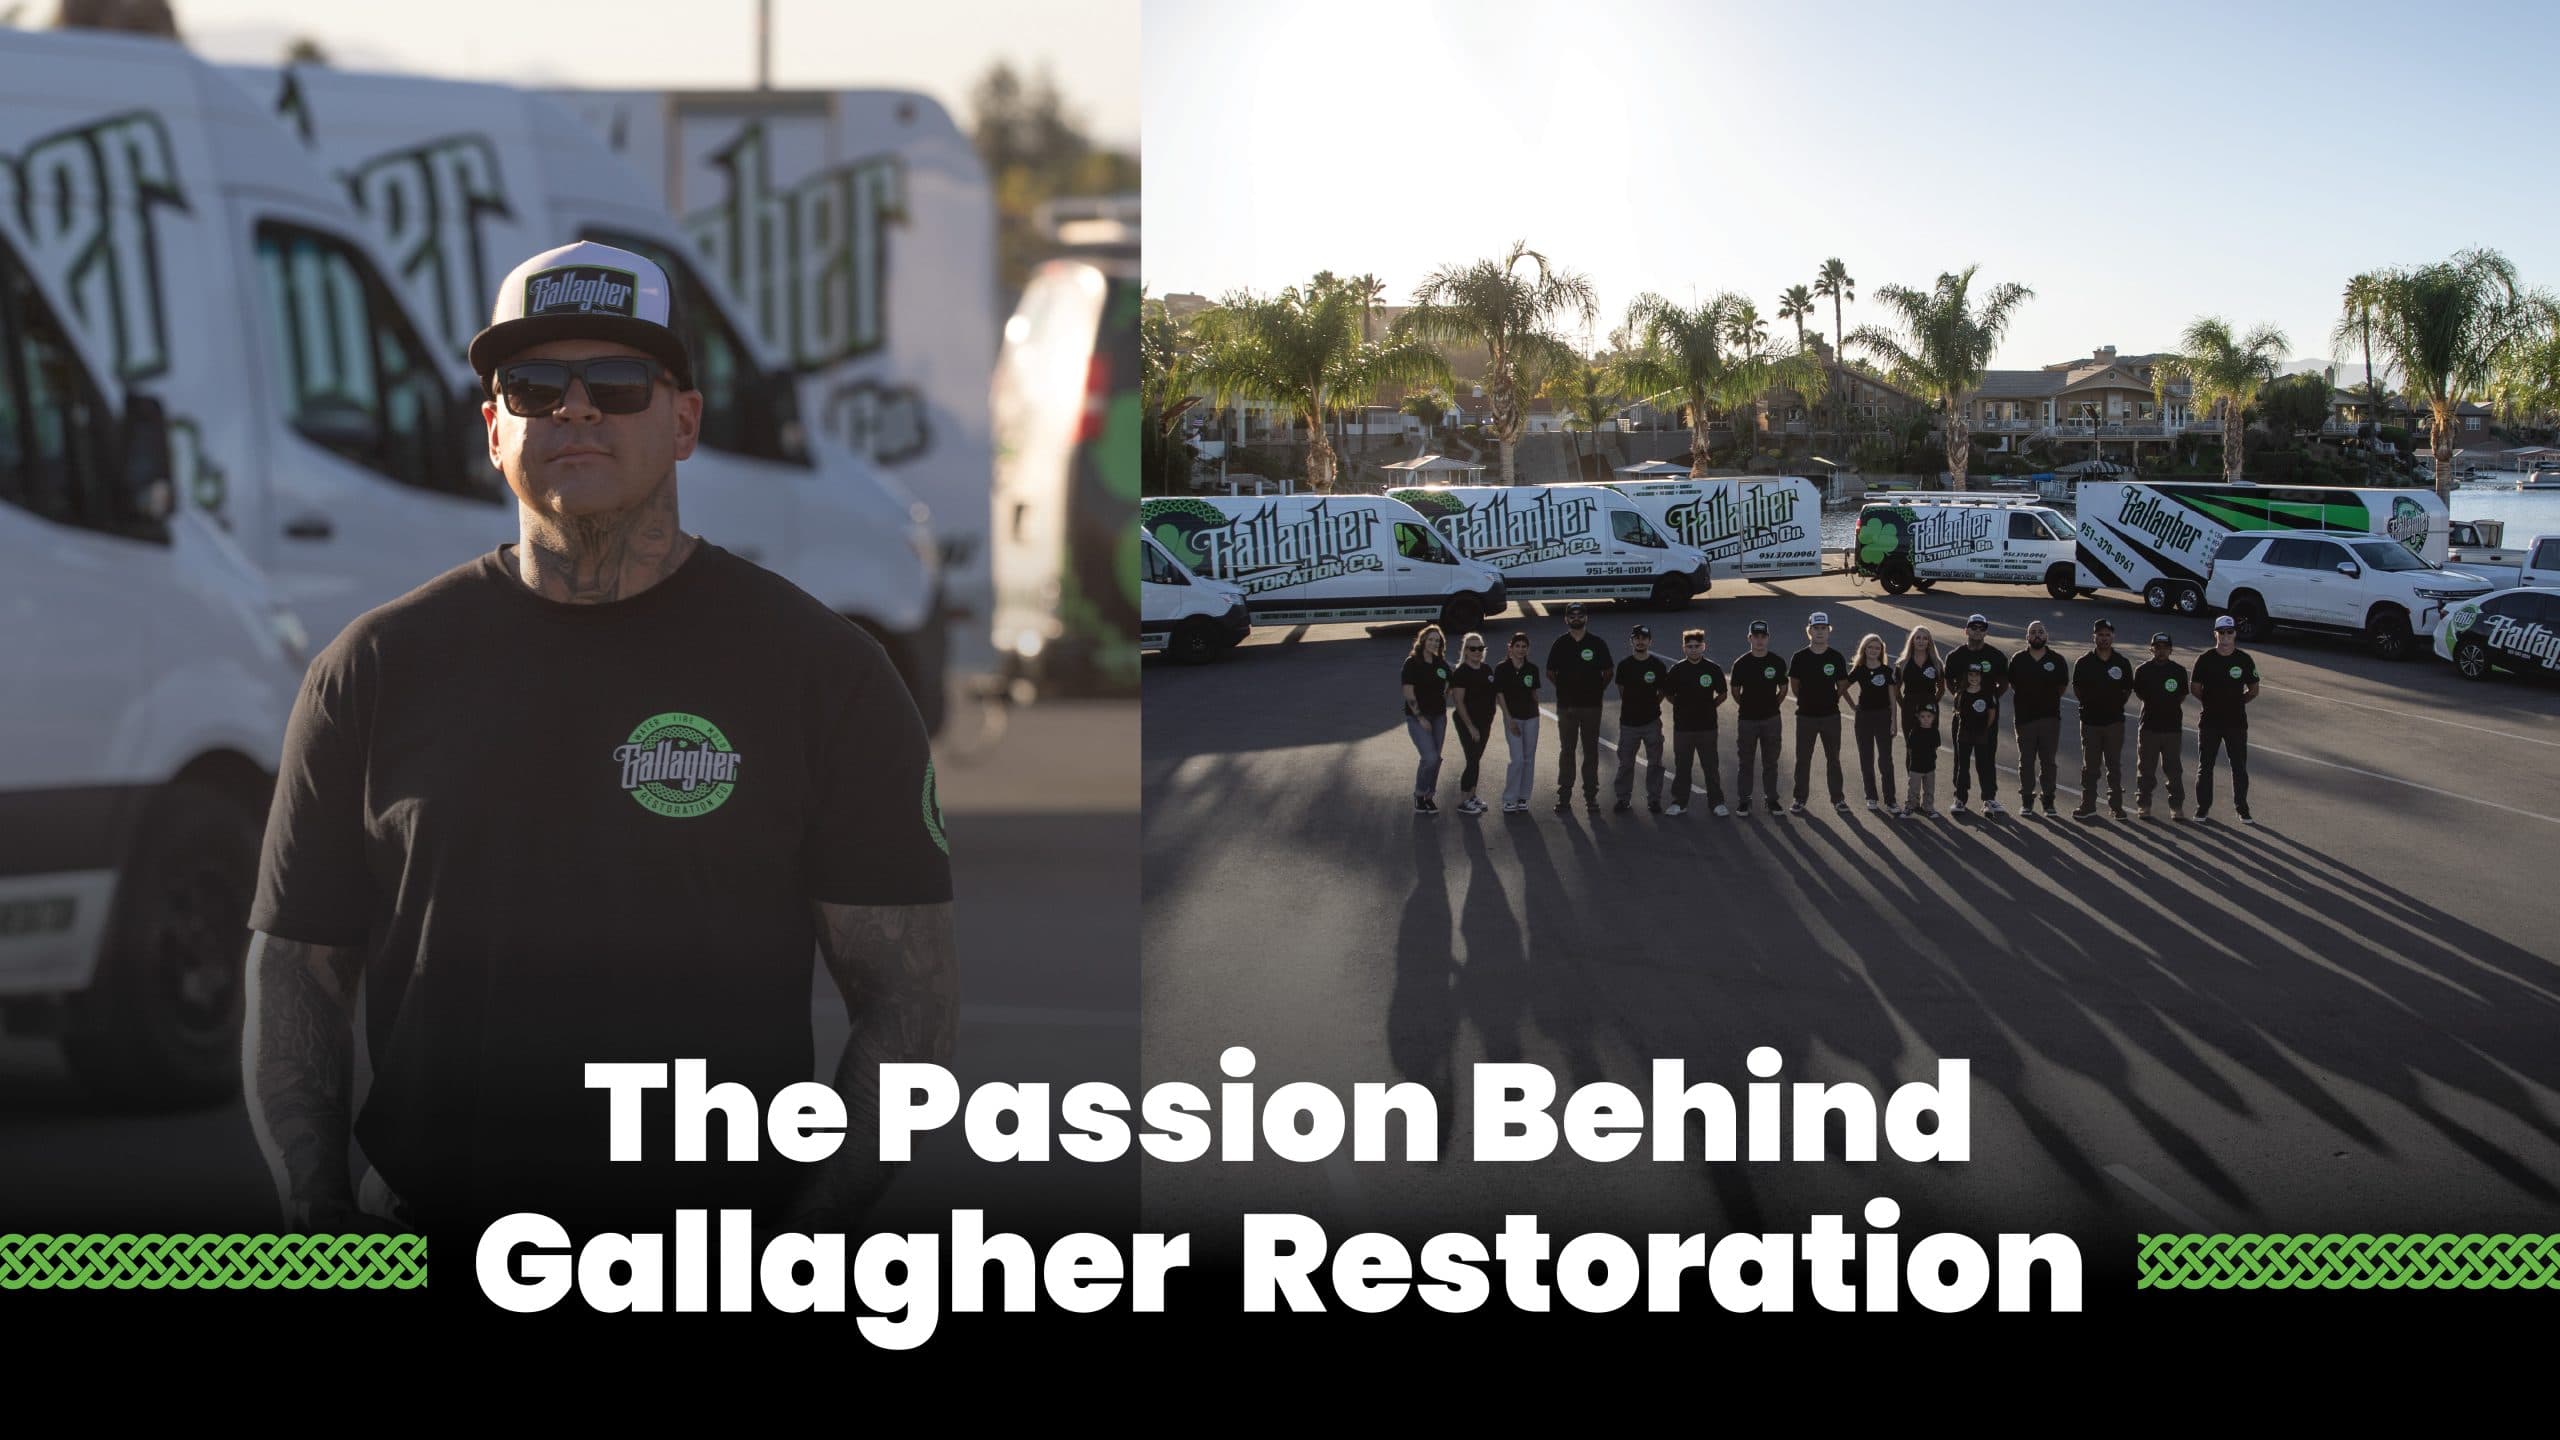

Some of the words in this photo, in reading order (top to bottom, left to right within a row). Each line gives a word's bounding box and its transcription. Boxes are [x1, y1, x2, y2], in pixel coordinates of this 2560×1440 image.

[529, 271, 632, 313] Gallagher
[1435, 488, 1597, 560] Gallagher
[1665, 481, 1800, 548] Gallagher
[1779, 525, 1805, 543] Co.
[1907, 508, 1993, 554] Gallagher
[2118, 485, 2203, 554] Gallagher
[1192, 498, 1380, 579] Gallagher
[1569, 537, 1600, 556] Co.
[2080, 522, 2135, 573] 951-370-0961
[1347, 554, 1384, 574] Co.
[634, 718, 660, 741] WATER
[613, 740, 741, 791] Gallagher
[639, 788, 714, 815] RESTORATION
